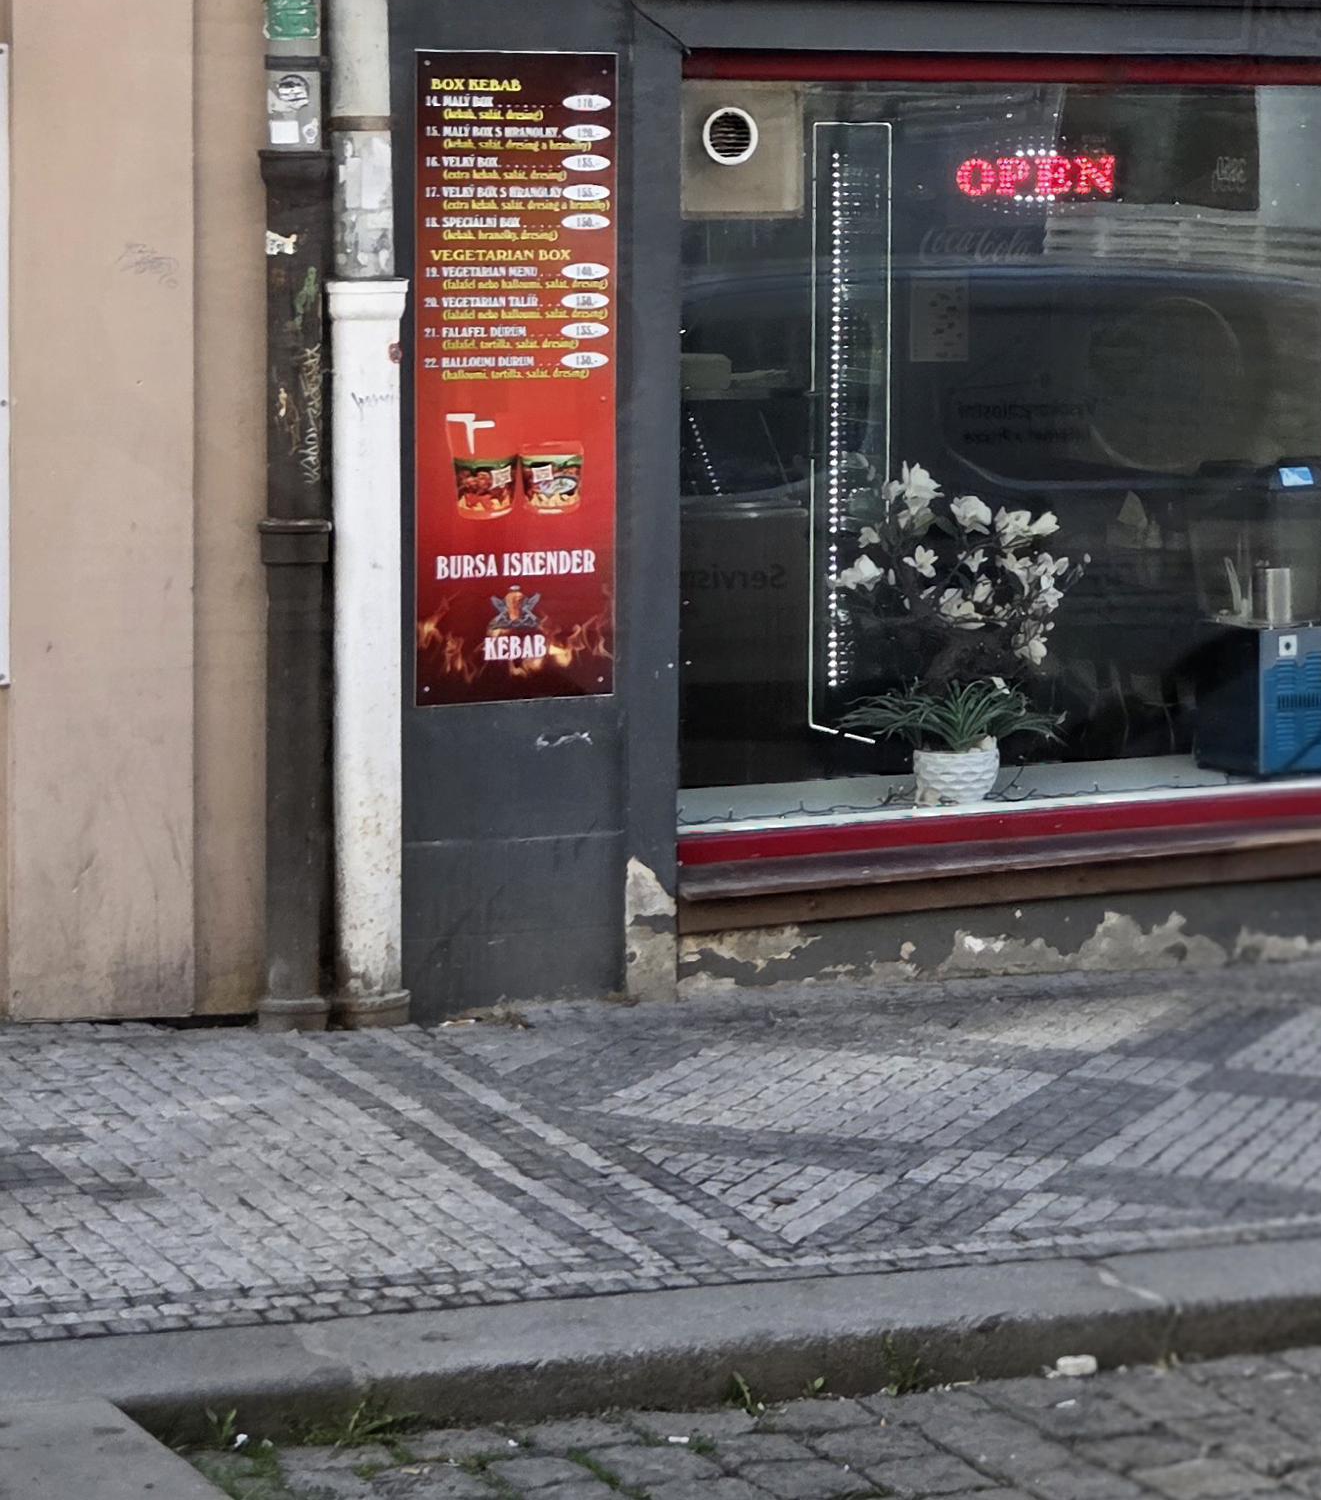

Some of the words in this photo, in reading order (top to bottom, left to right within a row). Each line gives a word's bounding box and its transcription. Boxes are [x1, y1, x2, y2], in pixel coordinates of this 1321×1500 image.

[431, 78, 465, 91] BOX
[469, 78, 521, 91] KEBAB
[473, 96, 493, 107] BOX
[473, 126, 493, 137] BOX
[495, 126, 502, 137] S
[477, 157, 498, 167] BOX
[956, 155, 1116, 197] OPEN
[477, 187, 498, 197] BOX
[500, 187, 506, 197] S
[500, 217, 520, 227] BOX
[431, 250, 534, 261] VEGETARIAN
[539, 249, 571, 260] BOX
[442, 267, 506, 277] VEGETARIAN
[442, 297, 505, 307] VEGETARIAN
[442, 327, 486, 337] FALAFEL
[436, 554, 498, 580] BURSA
[503, 549, 595, 577] ISKENDER
[484, 634, 546, 661] KEBAB
